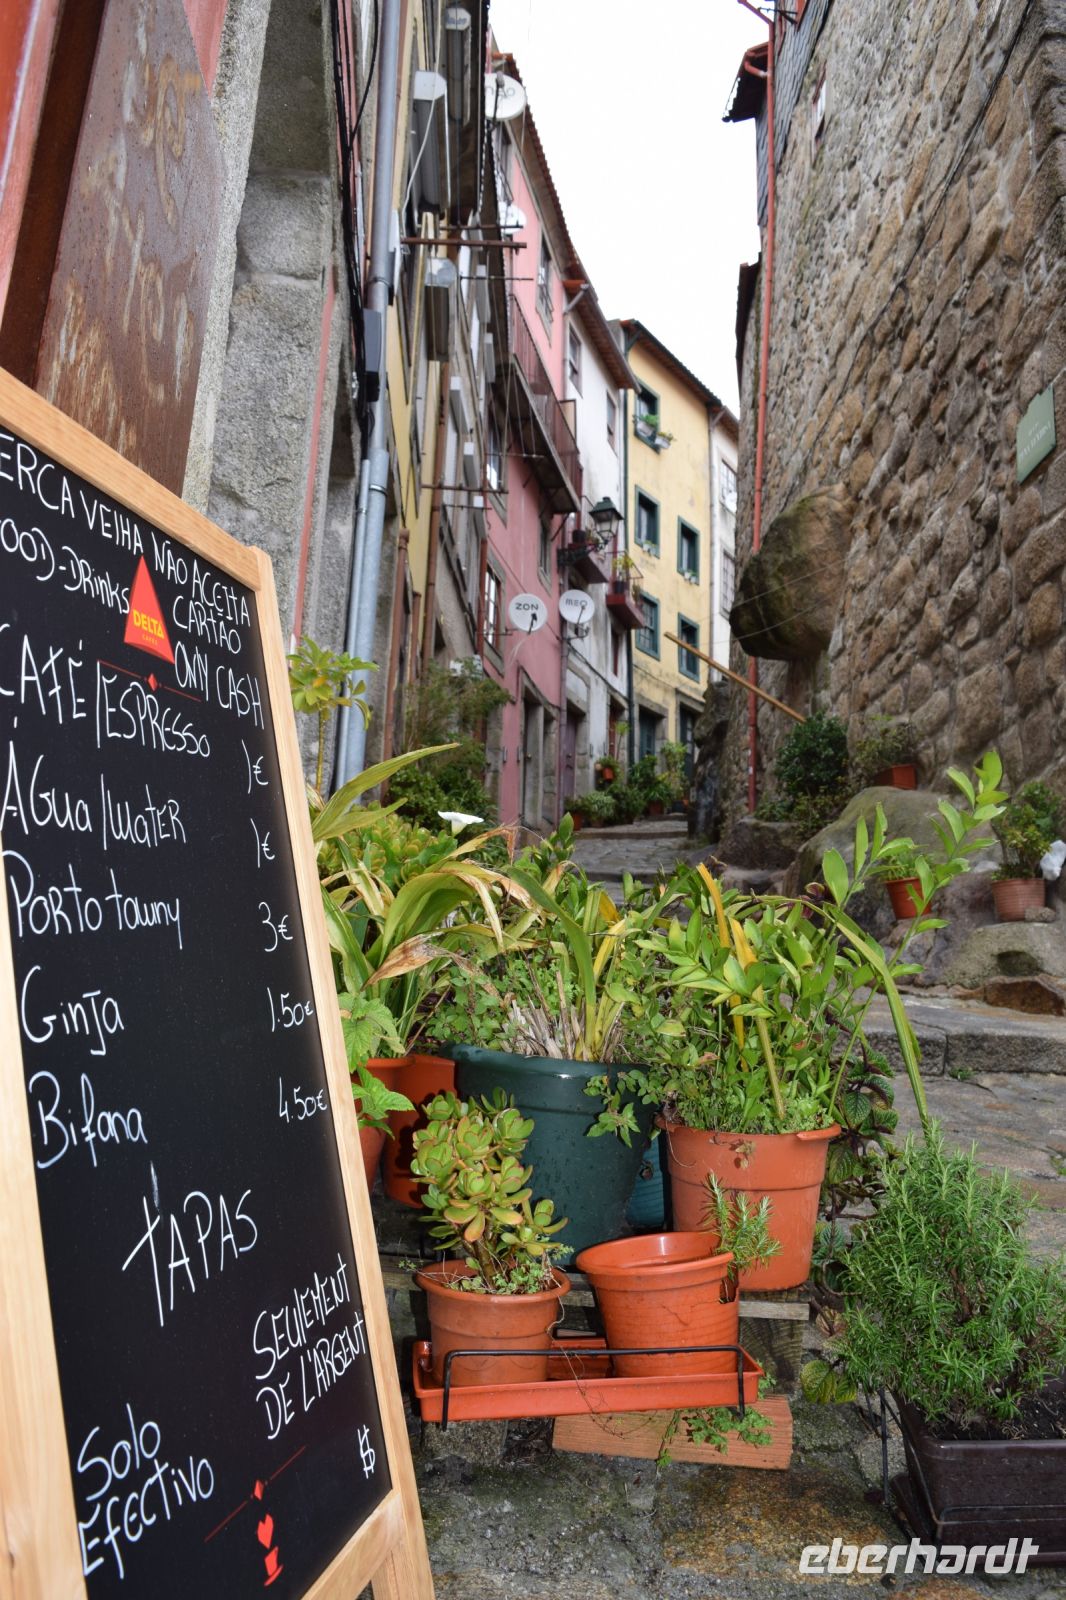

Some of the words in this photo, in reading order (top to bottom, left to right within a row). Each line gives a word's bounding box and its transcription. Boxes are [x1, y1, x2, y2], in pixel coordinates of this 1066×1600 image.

[132, 607, 165, 640] DELTA
[515, 602, 540, 611] ZON
[565, 598, 588, 608] MEO
[216, 665, 265, 730] CASH
[258, 901, 293, 952] 3€
[28, 1070, 149, 1169] Bifana
[278, 1076, 328, 1124] 4.50€
[255, 1372, 296, 1440] DE
